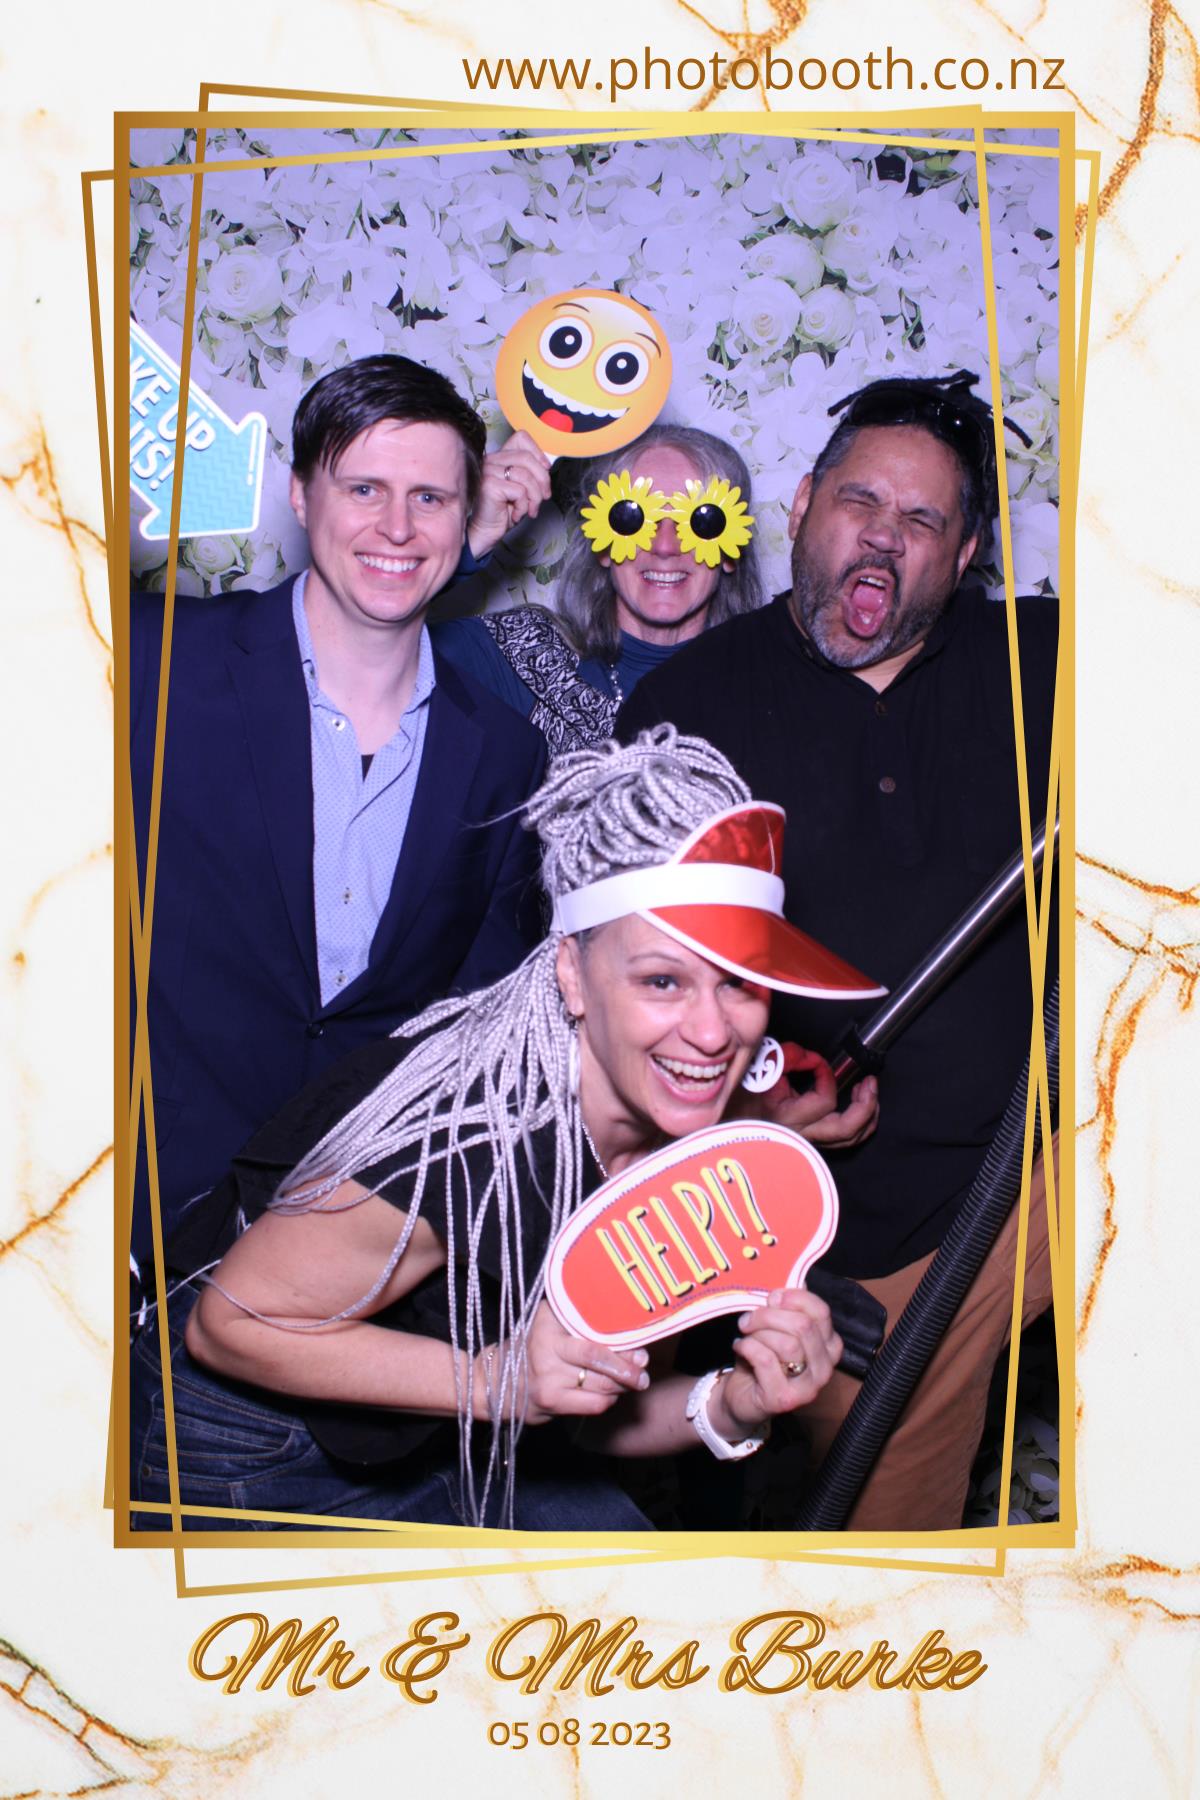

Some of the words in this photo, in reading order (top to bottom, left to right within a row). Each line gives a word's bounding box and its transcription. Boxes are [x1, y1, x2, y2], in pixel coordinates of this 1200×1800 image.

[130, 350, 172, 419] KE
[157, 401, 216, 452] UP
[595, 1157, 778, 1313] HELP!?
